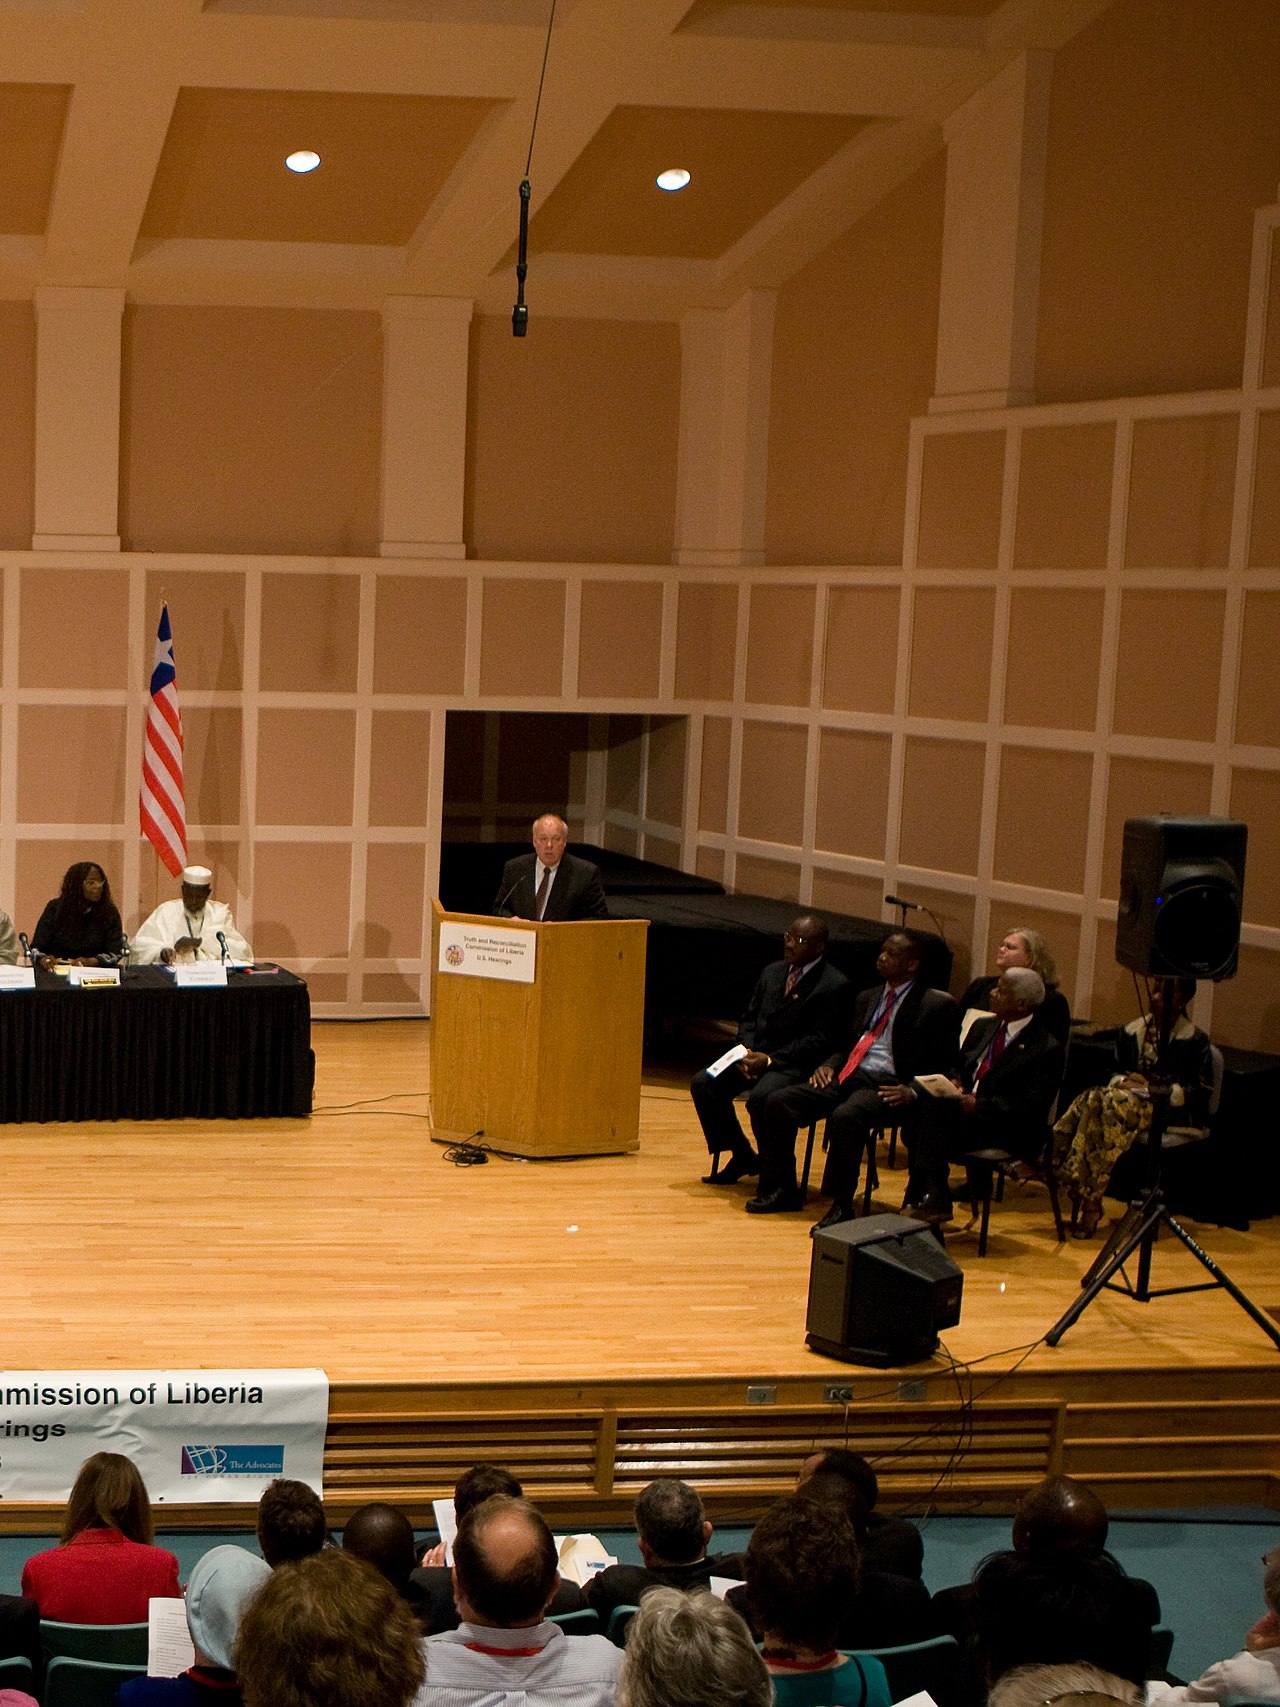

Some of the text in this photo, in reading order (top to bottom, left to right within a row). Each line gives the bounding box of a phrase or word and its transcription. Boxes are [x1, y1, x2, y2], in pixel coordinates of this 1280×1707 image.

[465, 943, 498, 952] Commission
[489, 939, 527, 948] Reconciliation
[488, 956, 512, 965] Hearings
[129, 1383, 157, 1405] of
[167, 1382, 264, 1405] Liberia
[229, 1460, 282, 1469] The Advocates
